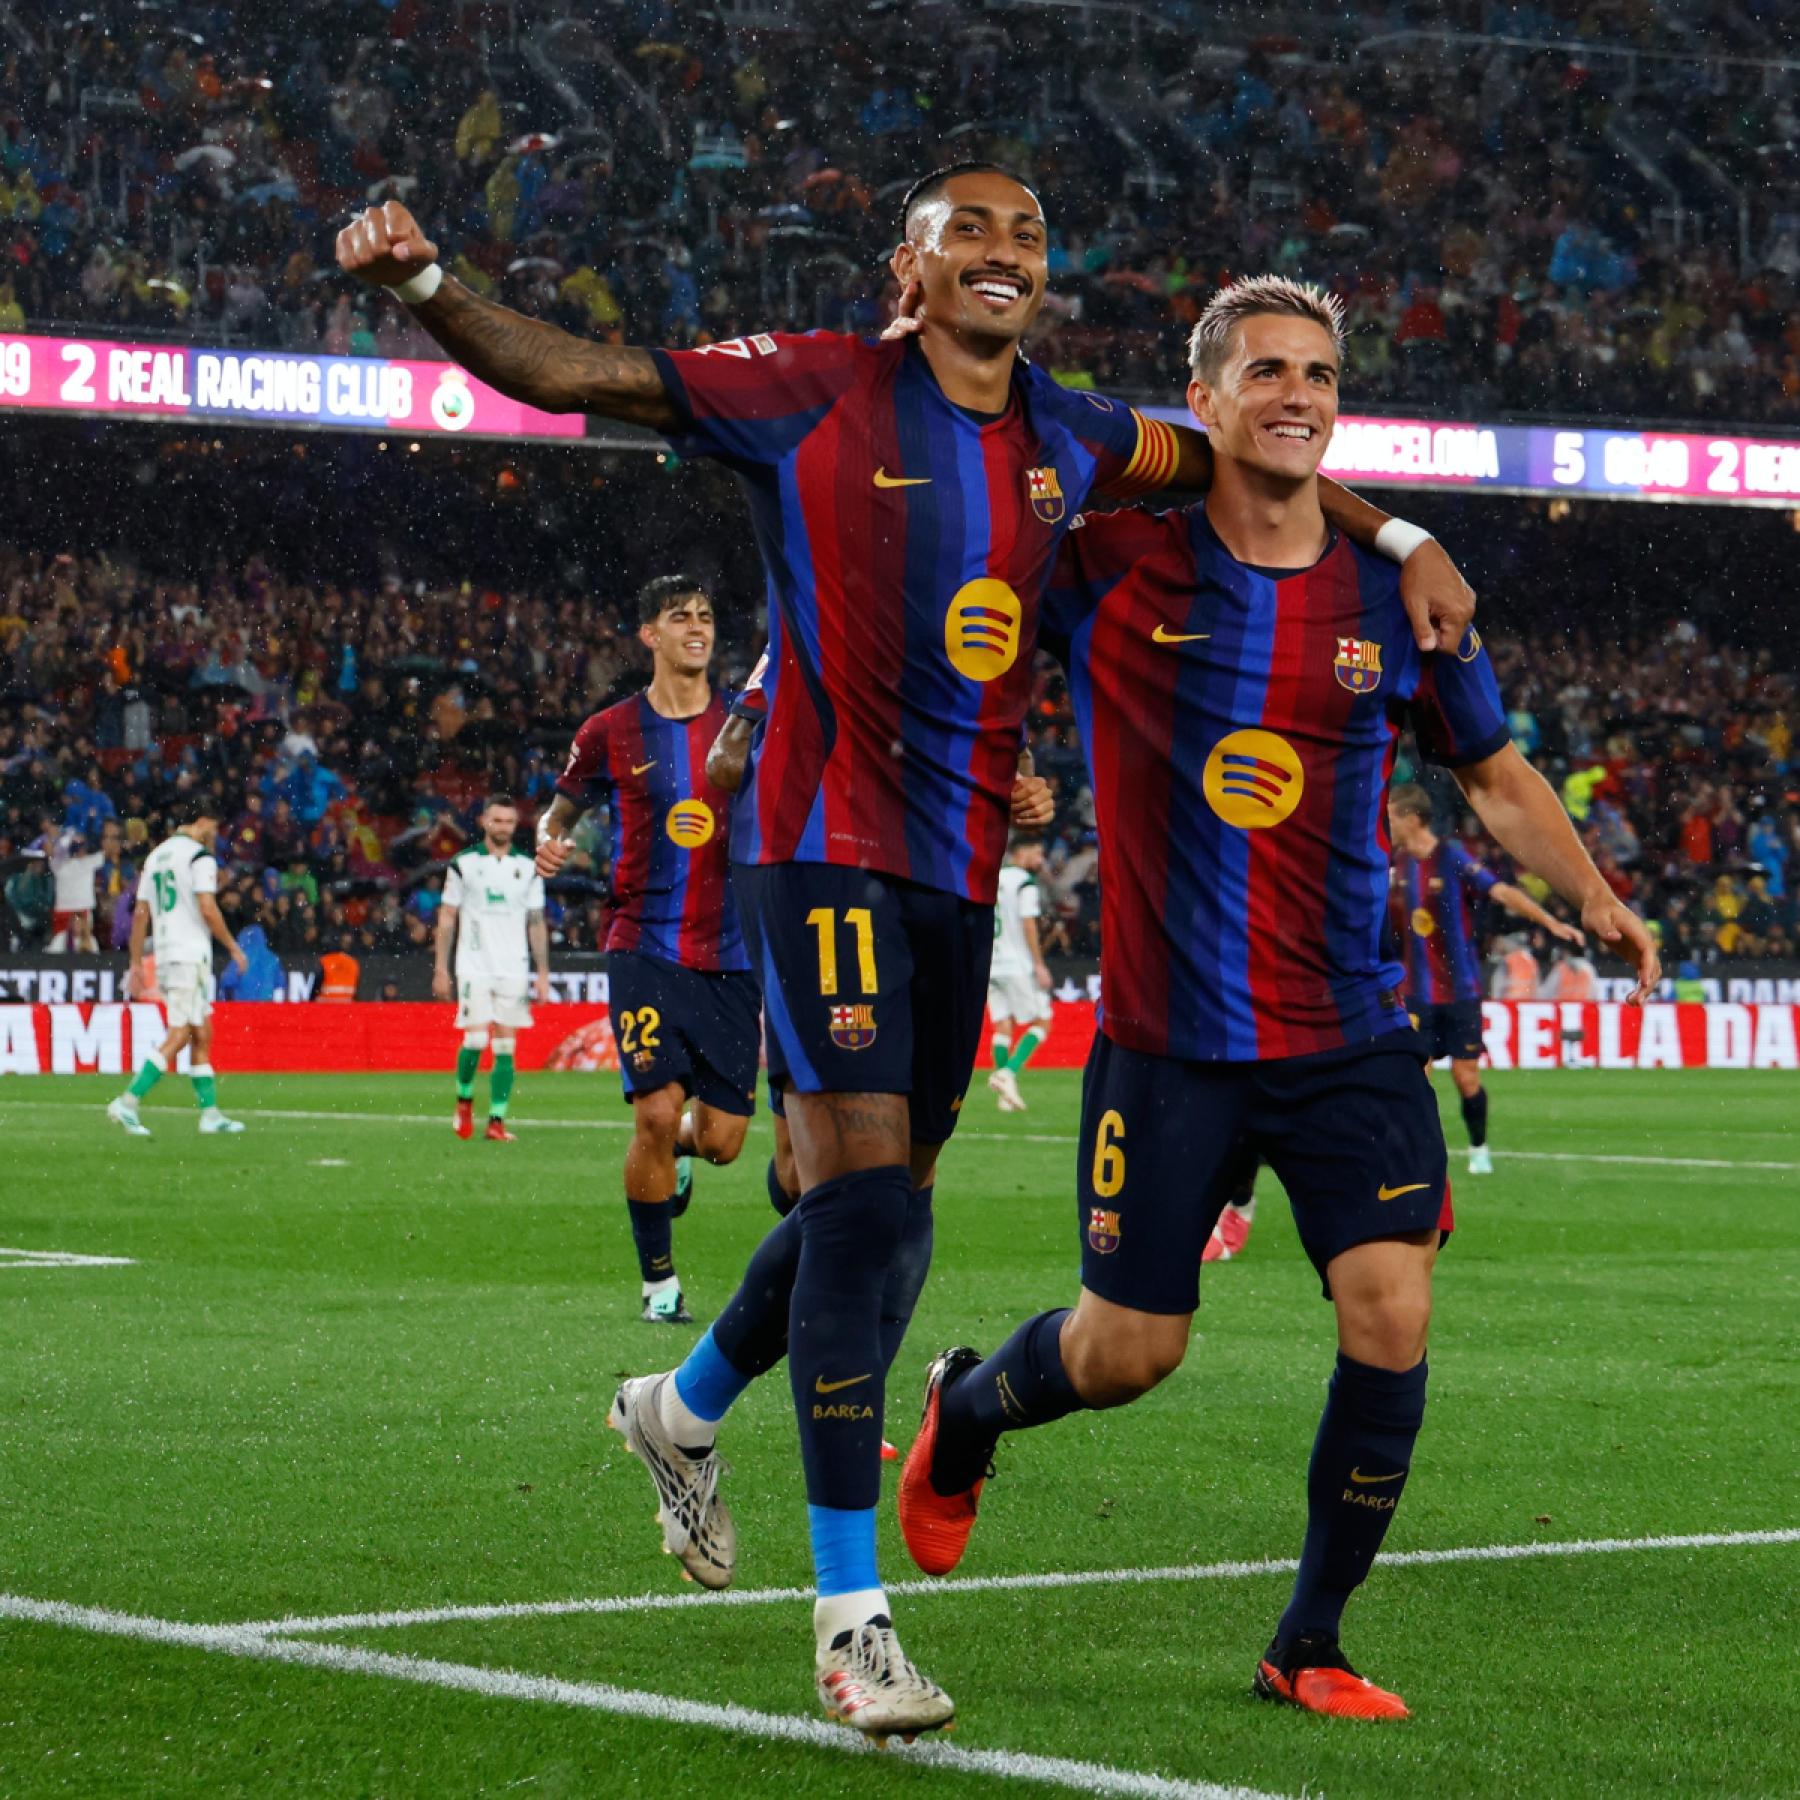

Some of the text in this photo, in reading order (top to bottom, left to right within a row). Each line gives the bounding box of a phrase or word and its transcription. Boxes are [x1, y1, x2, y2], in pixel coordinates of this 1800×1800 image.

[0, 341, 413, 419] 9 2 REAL RACING CLUB
[1553, 432, 1585, 484] 5
[1707, 441, 1739, 492] 2
[805, 907, 879, 996] 11
[619, 1006, 660, 1053] 22
[1433, 1003, 1682, 1068] RELLA
[1093, 1109, 1126, 1197] 6
[812, 1404, 874, 1421] BARÇA
